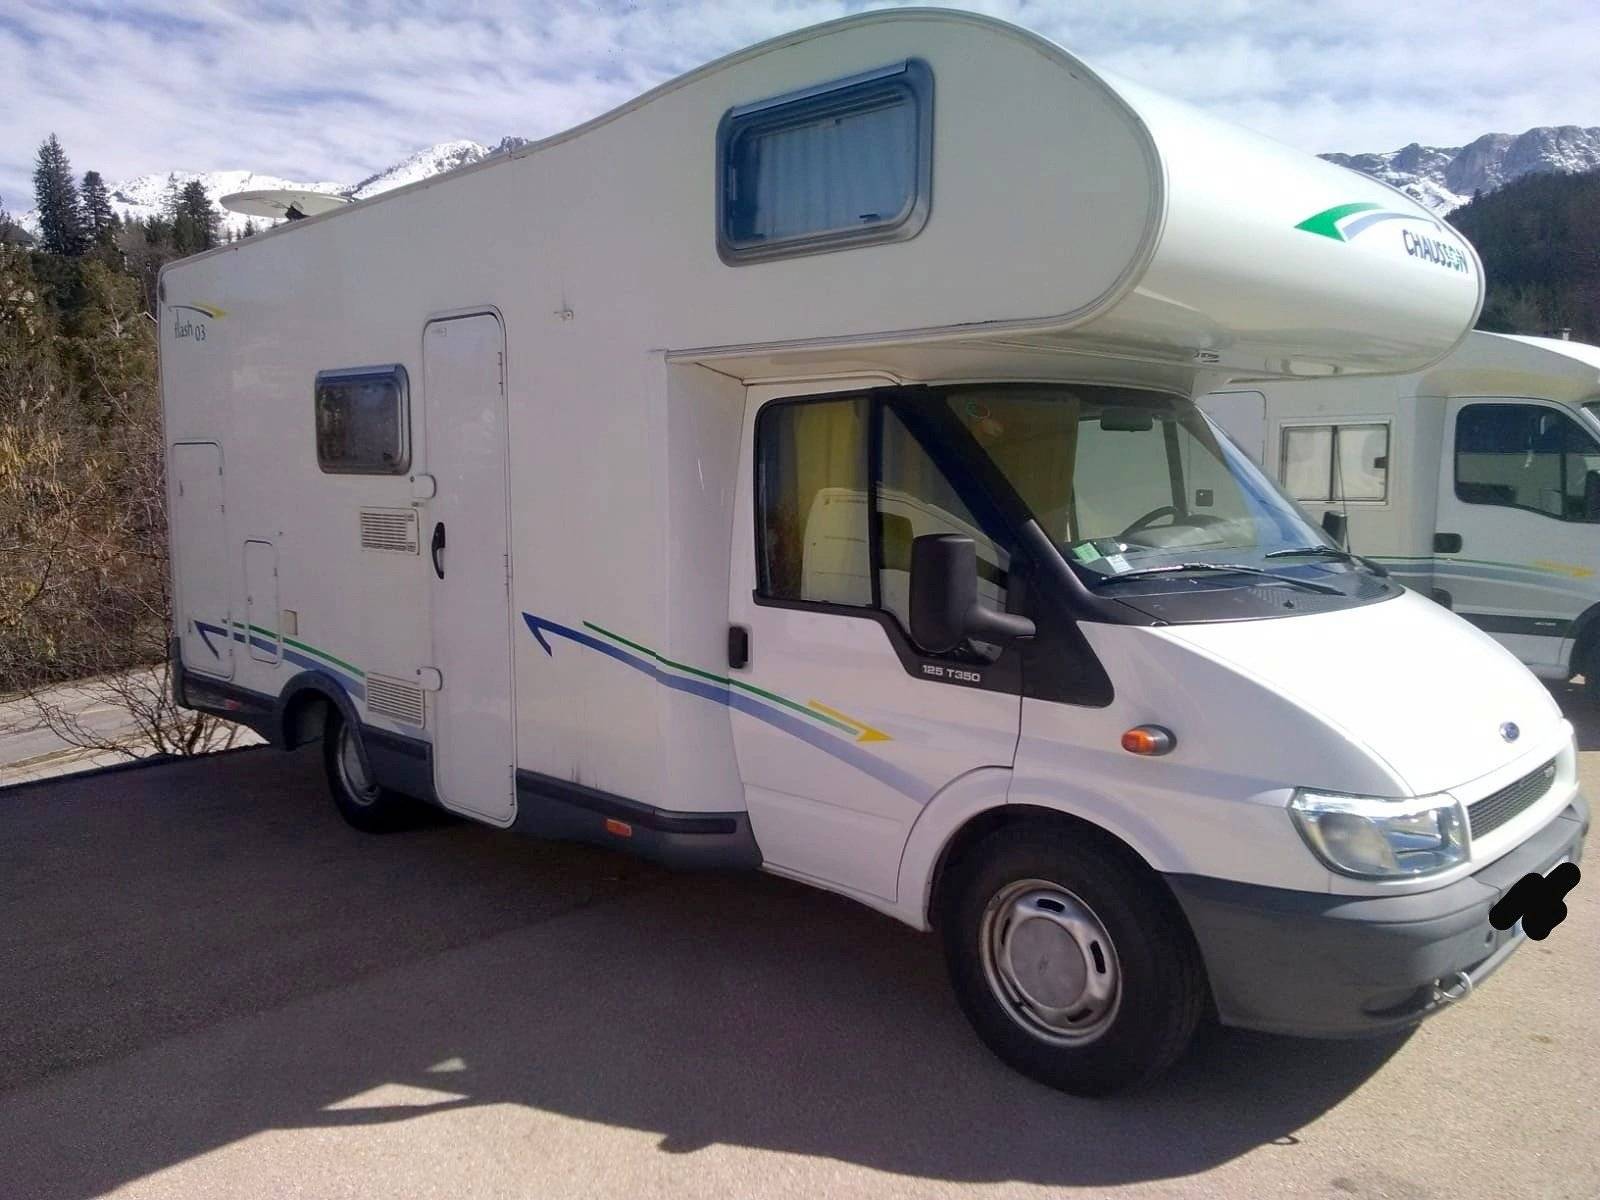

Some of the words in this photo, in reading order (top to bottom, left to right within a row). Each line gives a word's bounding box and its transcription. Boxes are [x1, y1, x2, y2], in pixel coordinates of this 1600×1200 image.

[1402, 228, 1469, 274] CHAUSSON
[194, 323, 206, 341] 03
[922, 664, 944, 676] 125
[946, 668, 981, 682] T350
